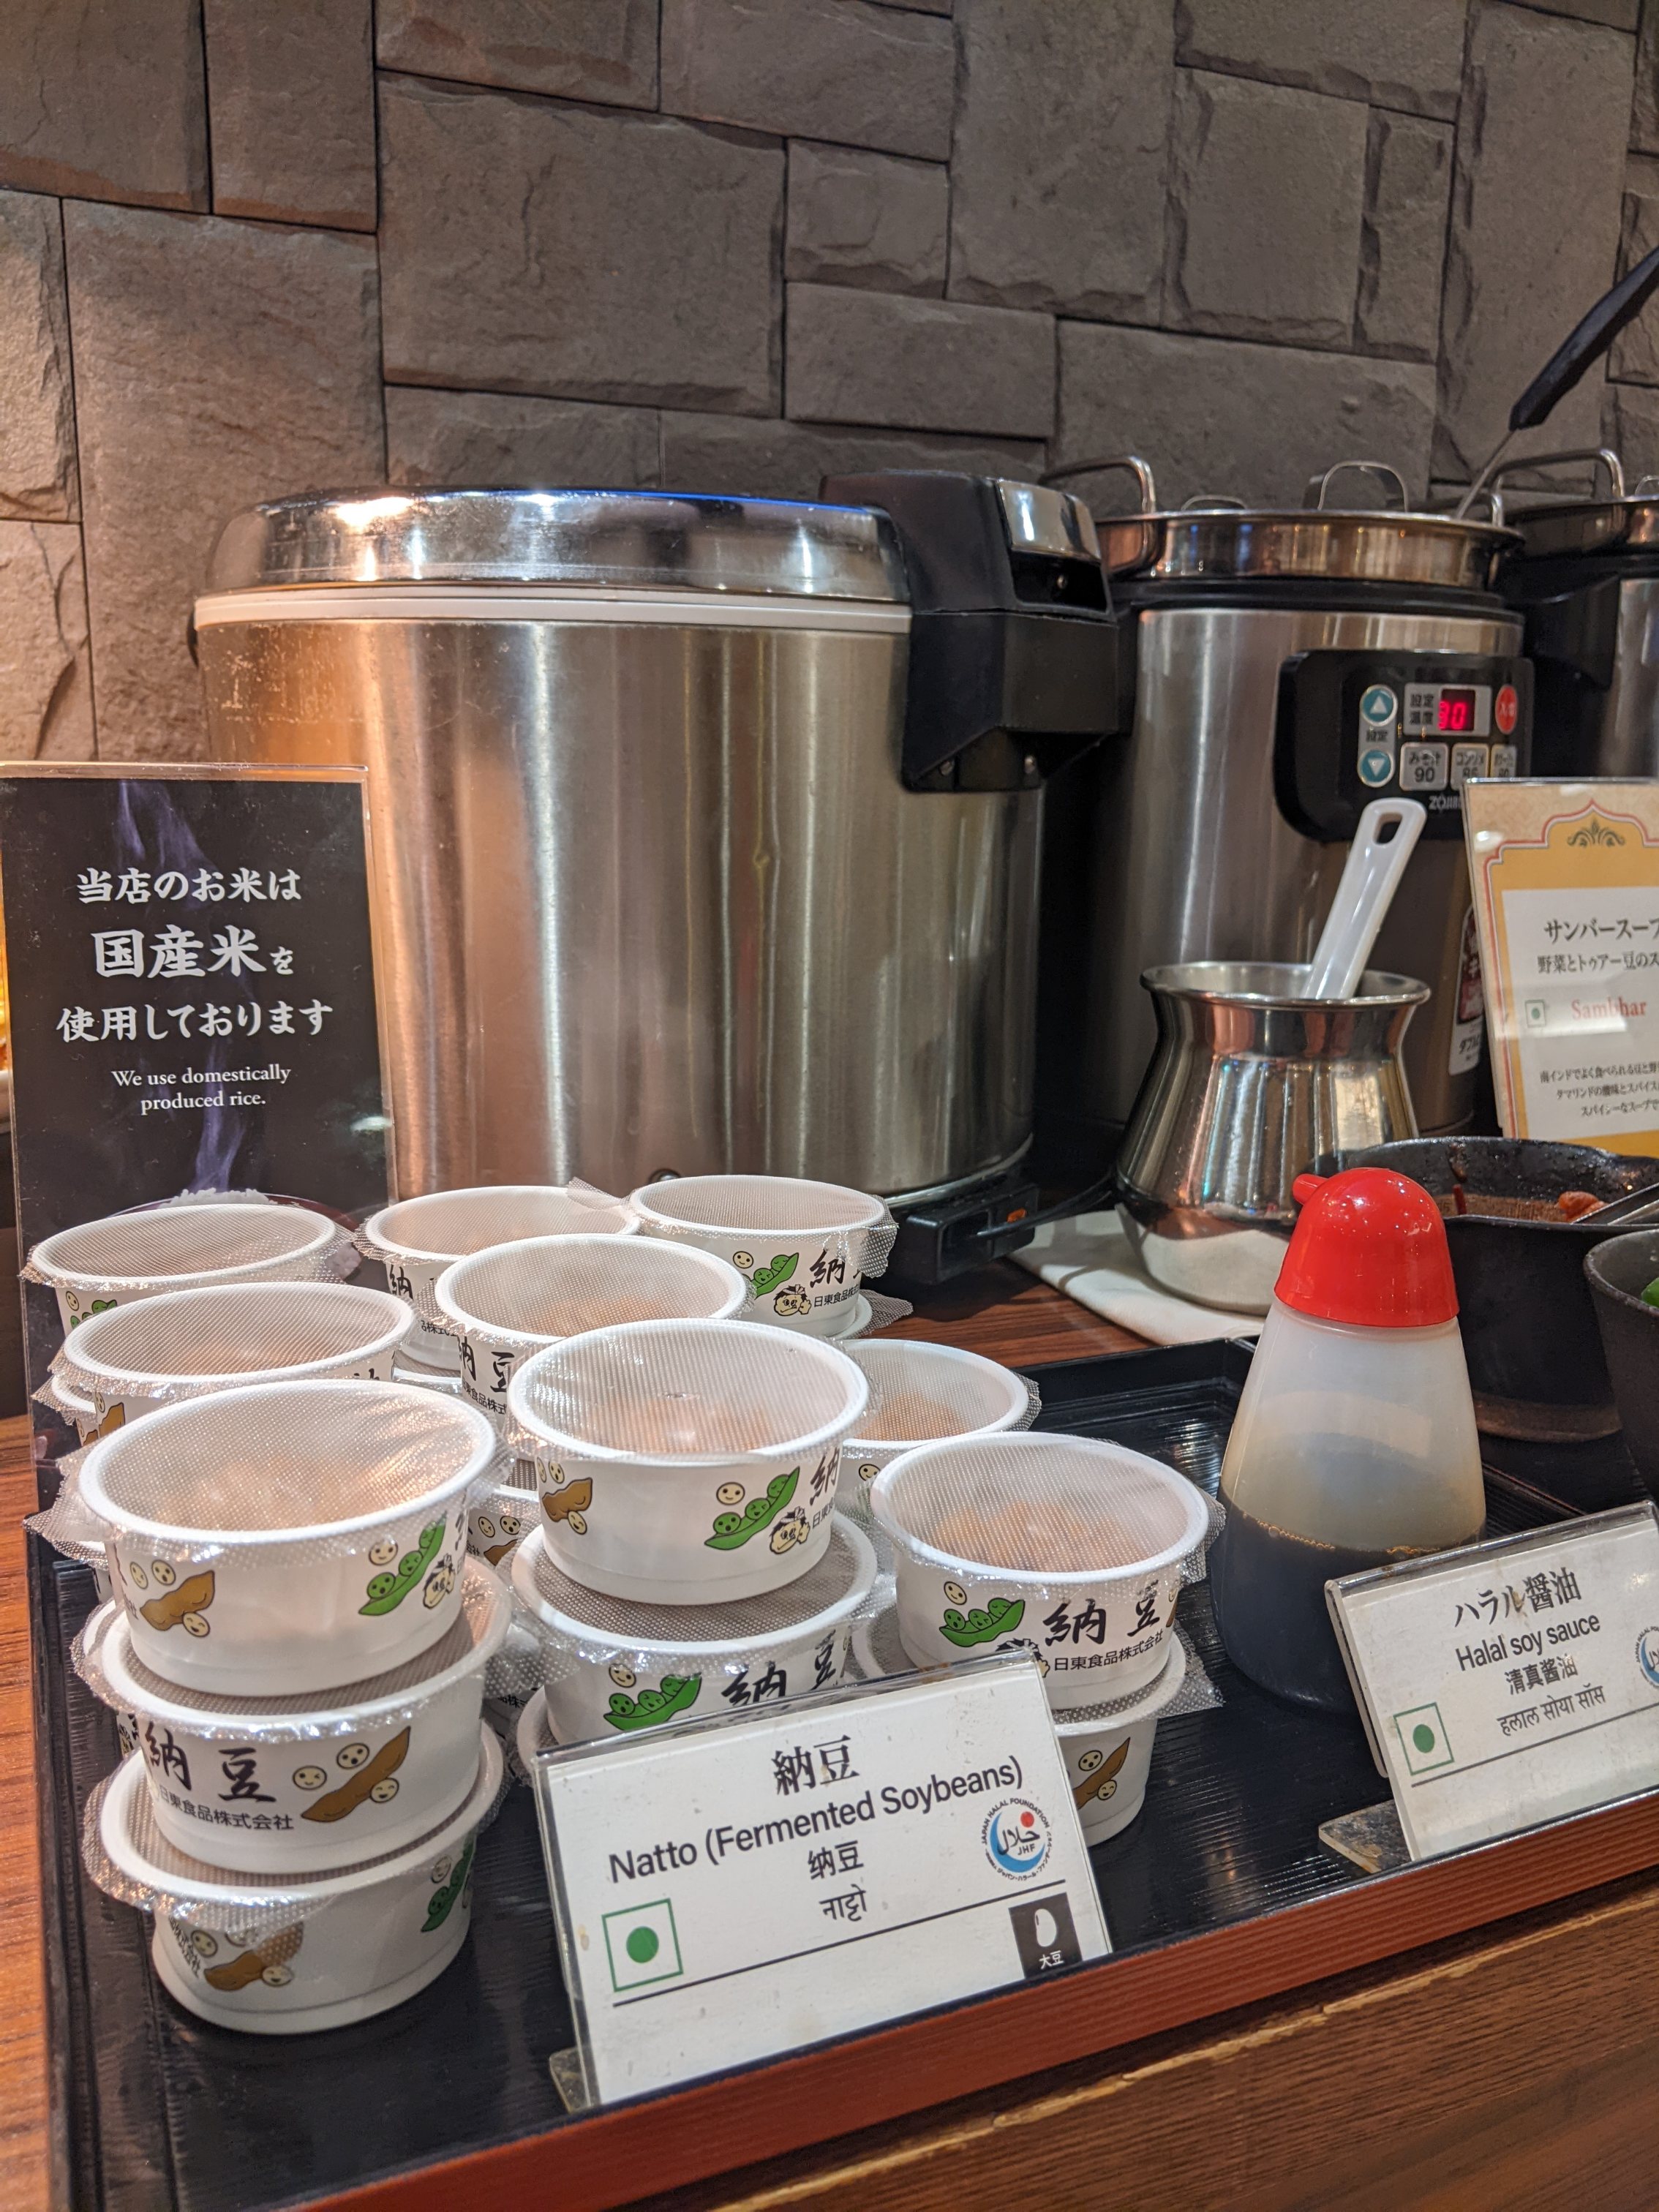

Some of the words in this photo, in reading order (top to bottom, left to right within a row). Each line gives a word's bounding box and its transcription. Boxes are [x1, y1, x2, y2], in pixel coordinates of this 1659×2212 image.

[1415, 768, 1434, 783] 90
[77, 868, 301, 904] 当店のお米は
[91, 924, 294, 979] 国産米を
[56, 998, 333, 1042] 使用しております
[111, 1070, 142, 1086] We
[147, 1073, 176, 1085] use
[181, 1064, 291, 1084] domestically
[140, 1091, 224, 1116] produced
[230, 1091, 266, 1106] rice.
[1042, 1579, 1161, 1647] 納豆
[1455, 1567, 1582, 1628] ハラル醤油
[1054, 1628, 1164, 1671] 日東食品株式会社
[1456, 1635, 1508, 1671] Halal
[1511, 1630, 1543, 1656] soy
[1546, 1614, 1600, 1645] sauce
[1497, 1707, 1540, 1737] हलाल
[1540, 1695, 1576, 1720] सोया
[145, 1720, 277, 1803] 納豆
[772, 1734, 860, 1797] 納豆
[159, 1785, 295, 1830] 日東食品株式会社
[609, 1840, 698, 1884] Natto
[705, 1790, 876, 1866] (Fermented
[880, 1755, 1023, 1815] Soybeans)
[981, 1818, 990, 1845] JAPAN
[988, 1799, 1009, 1818] HALAL
[1009, 1797, 1050, 1829] FOUNDATION
[808, 1840, 864, 1880] 纳豆
[996, 1825, 1041, 1856] حلال
[1017, 1843, 1036, 1856] JHF
[1039, 1949, 1064, 1970] 大豆
